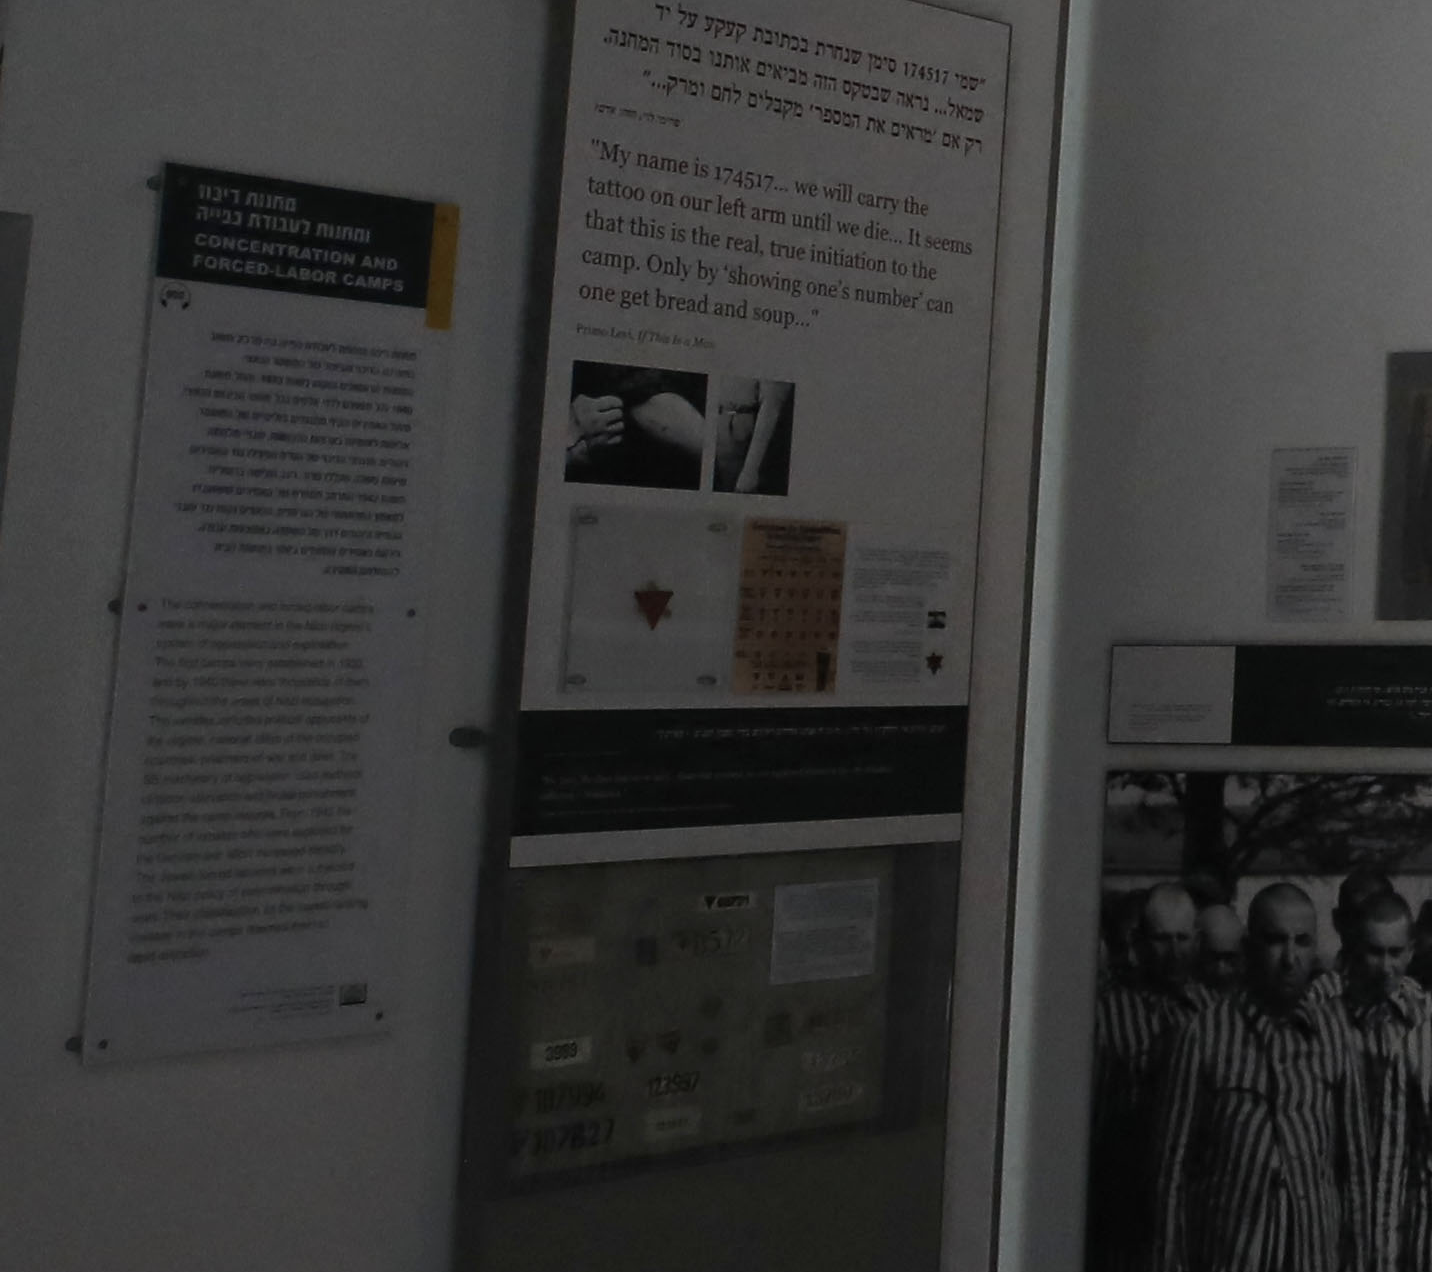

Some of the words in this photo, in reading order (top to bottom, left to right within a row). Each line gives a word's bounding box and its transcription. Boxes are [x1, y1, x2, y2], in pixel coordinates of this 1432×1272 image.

[655, 4, 671, 21] יד
[678, 3, 698, 28] על
[704, 15, 748, 44] קעקע
[753, 27, 809, 53] בכתובת
[666, 41, 702, 63] בסוד
[709, 49, 751, 73] אותנו
[868, 53, 898, 73] סימן
[757, 61, 808, 86] מביאים
[813, 73, 837, 91] הזה
[903, 61, 950, 85] 174517
[711, 81, 742, 104] לחם
[843, 79, 891, 102] שבטקס
[896, 90, 930, 112] נראה
[748, 90, 805, 120] מקבלים
[867, 117, 887, 134] את
[942, 132, 961, 149] אם
[964, 137, 983, 157] רק
[591, 138, 632, 169] "My
[636, 152, 689, 175] name
[694, 157, 709, 178] is
[715, 166, 790, 193] 174517...
[795, 180, 819, 198] we
[823, 183, 853, 204] will
[857, 191, 901, 215] carry
[904, 195, 930, 217] the
[588, 176, 645, 202] tattoo
[651, 189, 675, 207] on
[680, 197, 713, 215] our
[717, 194, 746, 219] left
[751, 207, 787, 225] arm
[792, 213, 832, 232] until
[836, 220, 860, 237] we
[864, 220, 903, 245] die...
[908, 228, 921, 247] It
[926, 235, 974, 256] seems
[194, 232, 357, 267] CONCENTRATION
[360, 255, 399, 272] AND
[586, 209, 625, 234] that
[630, 216, 667, 240] this
[671, 222, 686, 243] is
[692, 225, 722, 247] the
[727, 234, 765, 256] real,
[770, 240, 806, 261] true
[810, 244, 886, 274] initiation
[892, 259, 908, 276] to
[913, 260, 937, 281] the
[192, 253, 338, 285] FORCED-LABOR
[342, 273, 405, 294] CAMPS
[582, 249, 641, 275] camp.
[647, 253, 692, 282] Only
[697, 259, 720, 286] by
[807, 278, 850, 301] one's
[927, 297, 954, 315] can
[579, 283, 617, 303] one
[620, 289, 650, 310] get
[656, 288, 710, 315] bread
[714, 299, 748, 320] and
